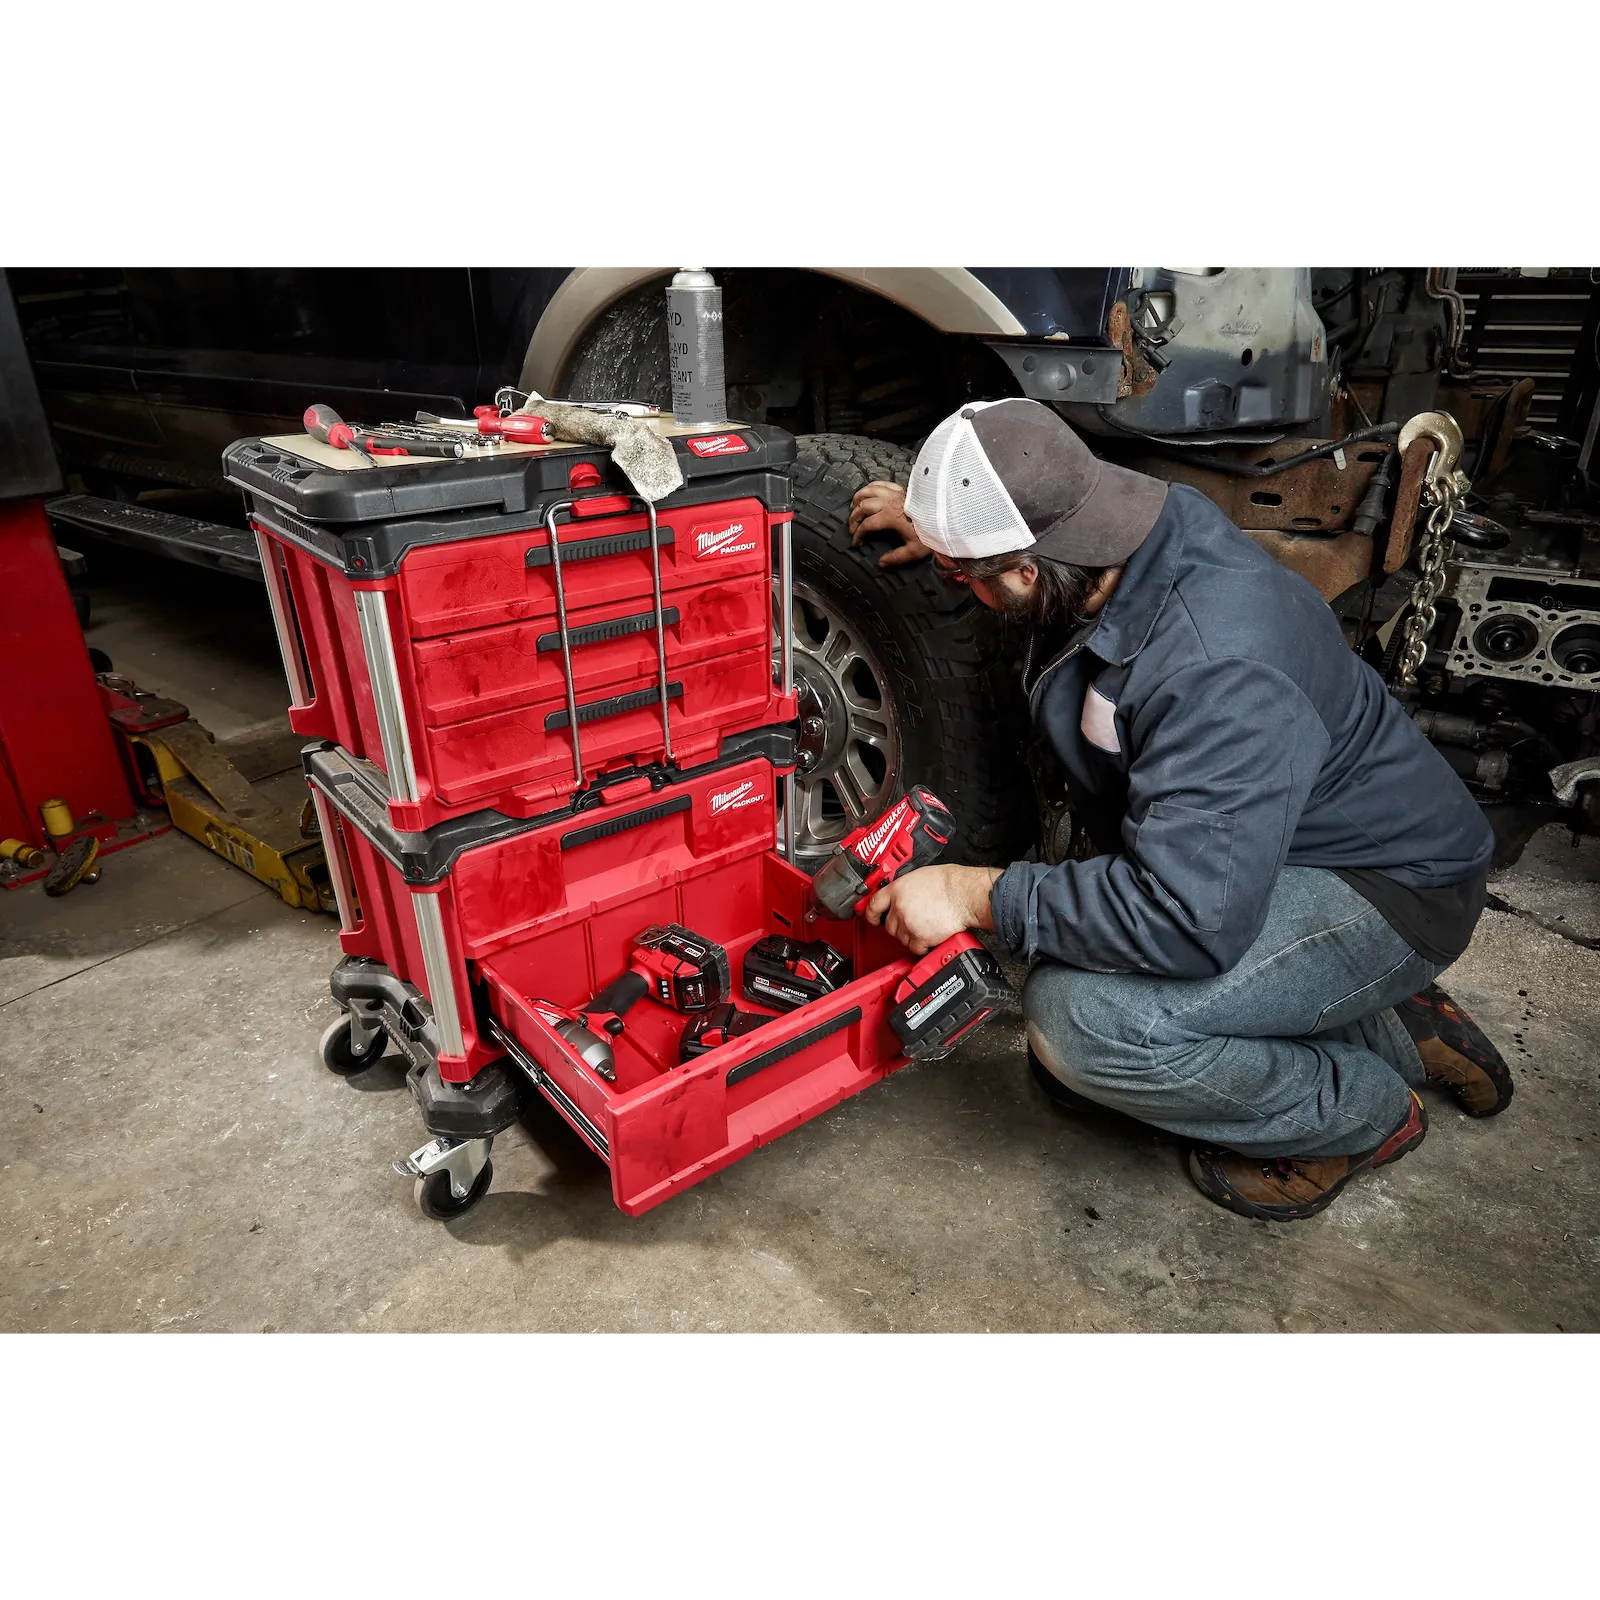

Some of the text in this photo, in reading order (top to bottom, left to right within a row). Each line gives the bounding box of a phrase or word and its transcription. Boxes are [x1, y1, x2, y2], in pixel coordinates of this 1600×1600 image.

[695, 524, 744, 552] Milwaukee
[720, 542, 756, 554] PACKOUT
[710, 781, 753, 811] Milwaukee
[732, 794, 765, 809] PACKOUT
[855, 801, 907, 861] Milwaukee
[906, 816, 919, 832] FUEL
[920, 974, 958, 1008] REDLITHIUM
[910, 1011, 925, 1025] HIGH
[924, 994, 946, 1014] OUTPUT
